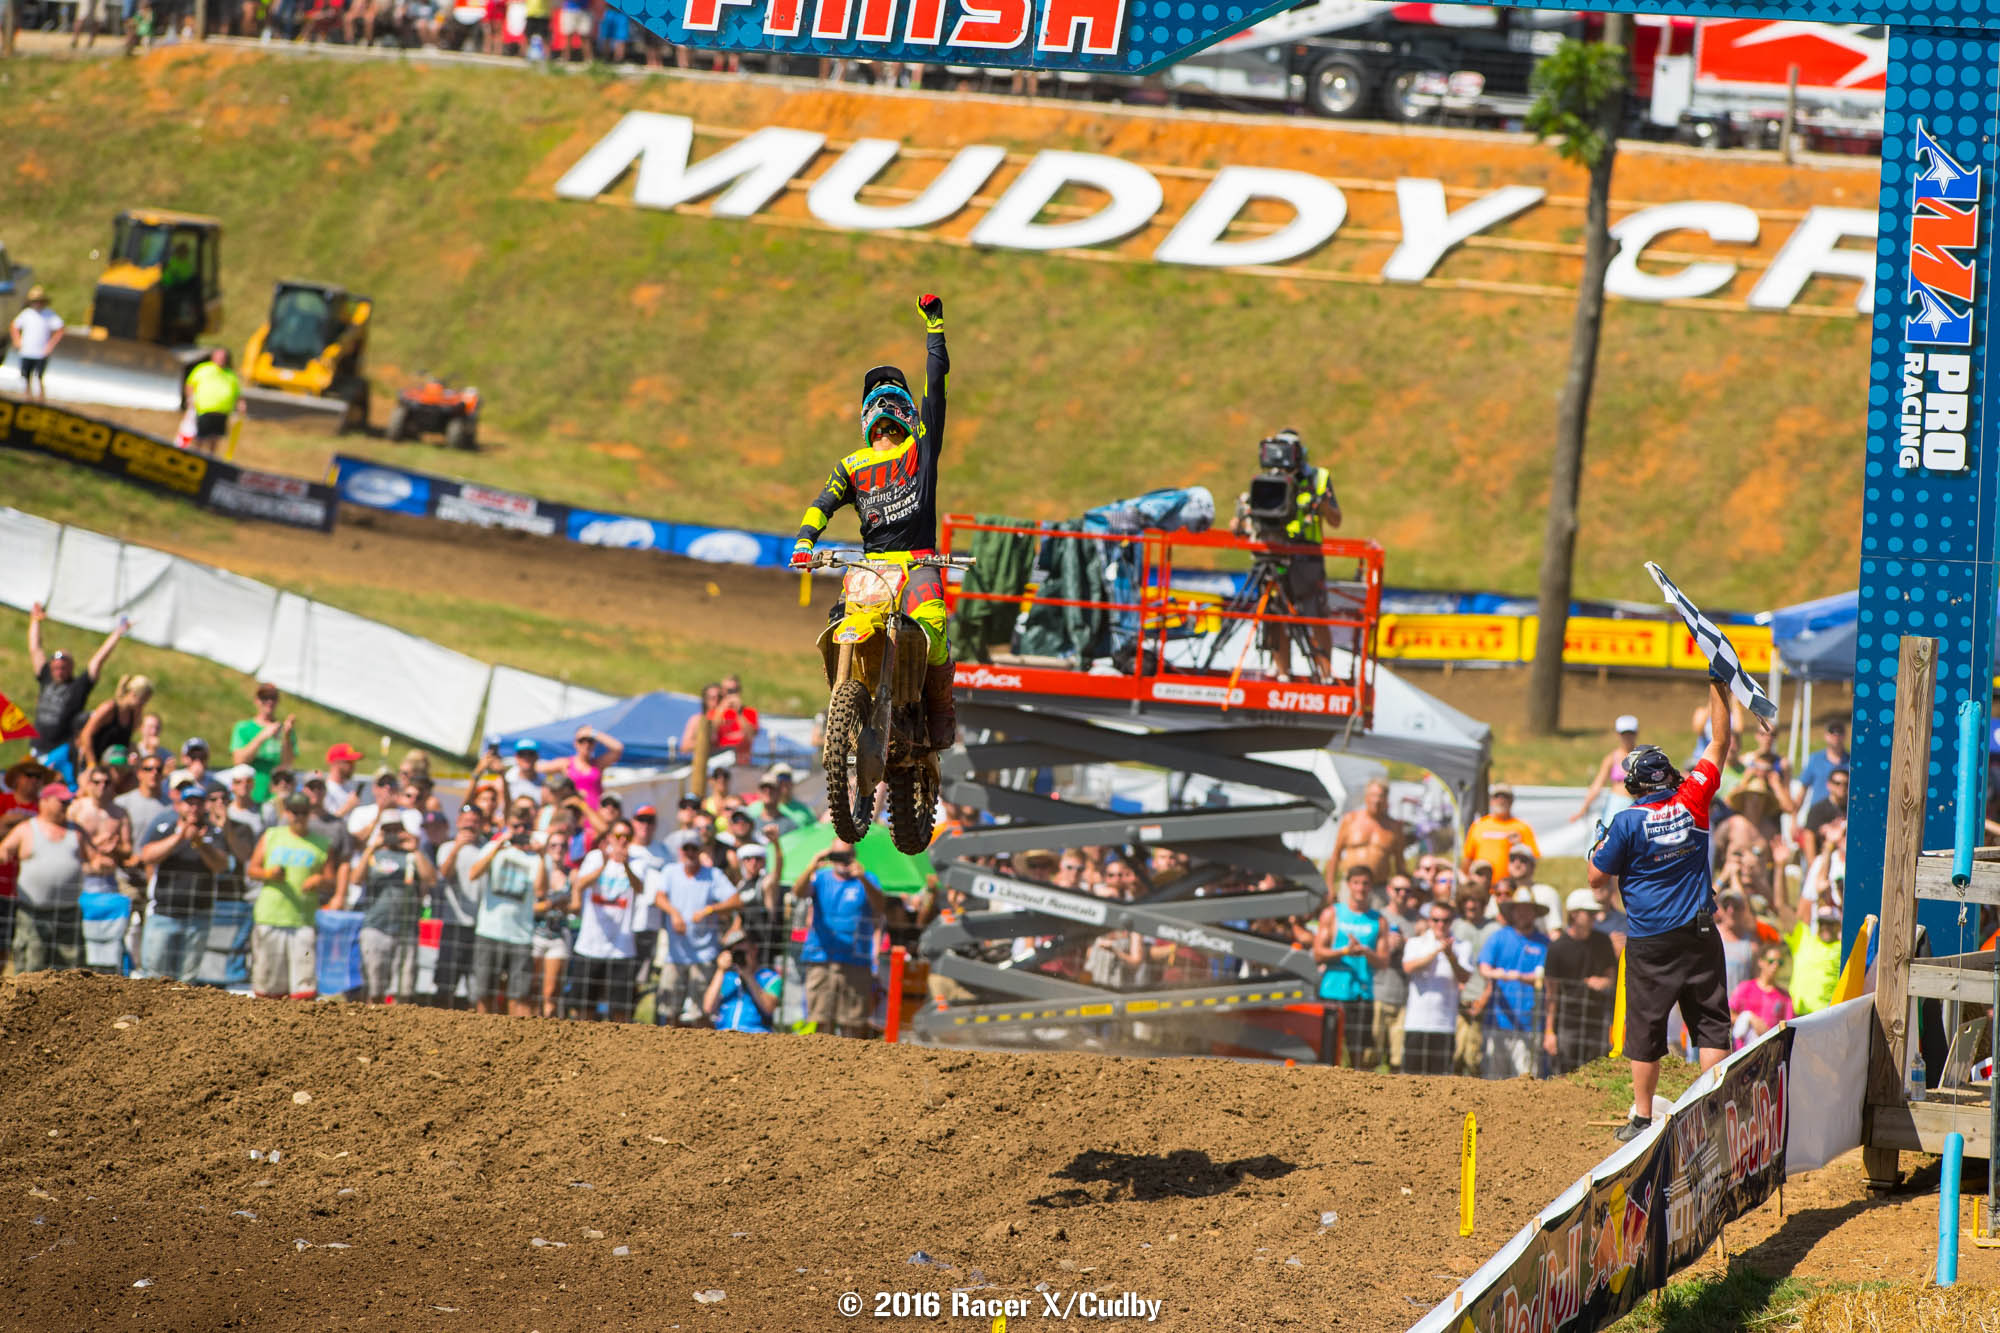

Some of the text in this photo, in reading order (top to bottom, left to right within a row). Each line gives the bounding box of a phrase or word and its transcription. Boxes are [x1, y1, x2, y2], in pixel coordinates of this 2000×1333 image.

[554, 110, 1545, 283] MUDDY
[1905, 118, 1981, 345] AMA
[1898, 352, 1925, 470] RACING
[1922, 353, 1970, 472] PRO
[859, 490, 893, 510] Soaring
[883, 491, 917, 516] JIMMY
[1267, 690, 1351, 714] SJ7135 RT
[1157, 924, 1234, 953] SKYJACK
[1541, 1221, 1583, 1333] Bull
